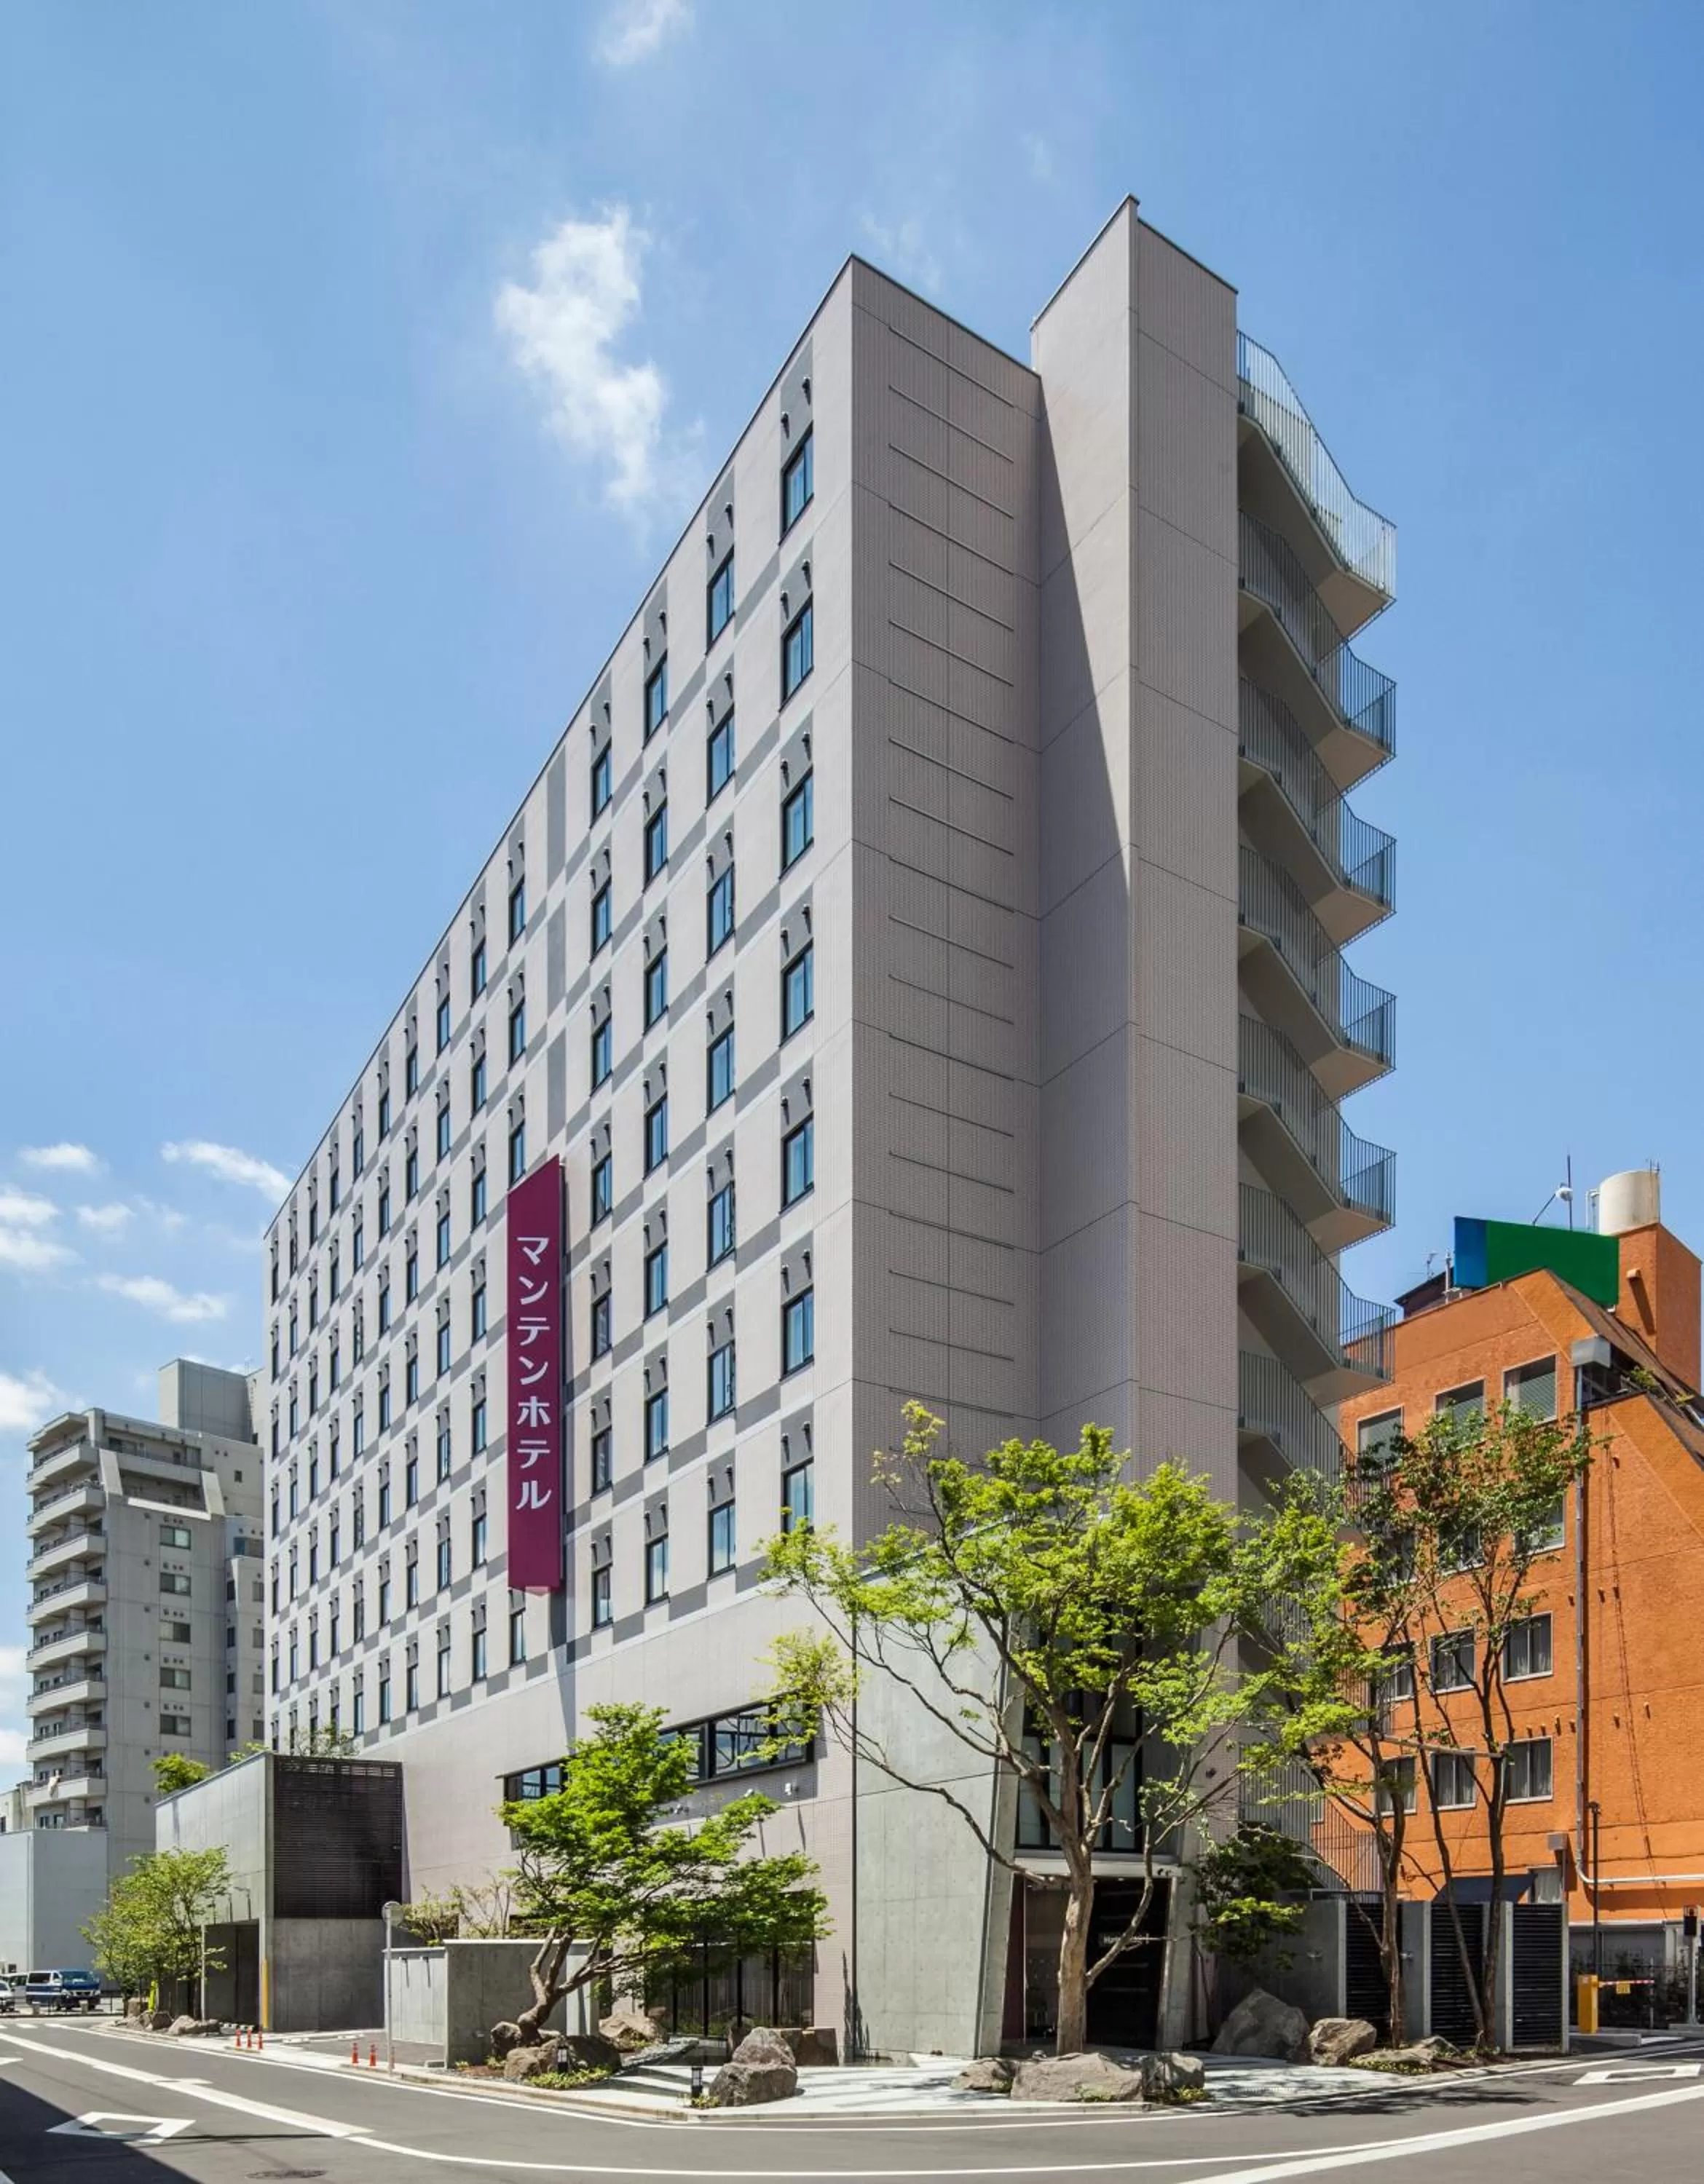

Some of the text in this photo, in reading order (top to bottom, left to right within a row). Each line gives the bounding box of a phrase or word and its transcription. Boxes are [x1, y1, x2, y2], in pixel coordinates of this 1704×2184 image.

[516, 1237, 551, 1510] マンテンホテル
